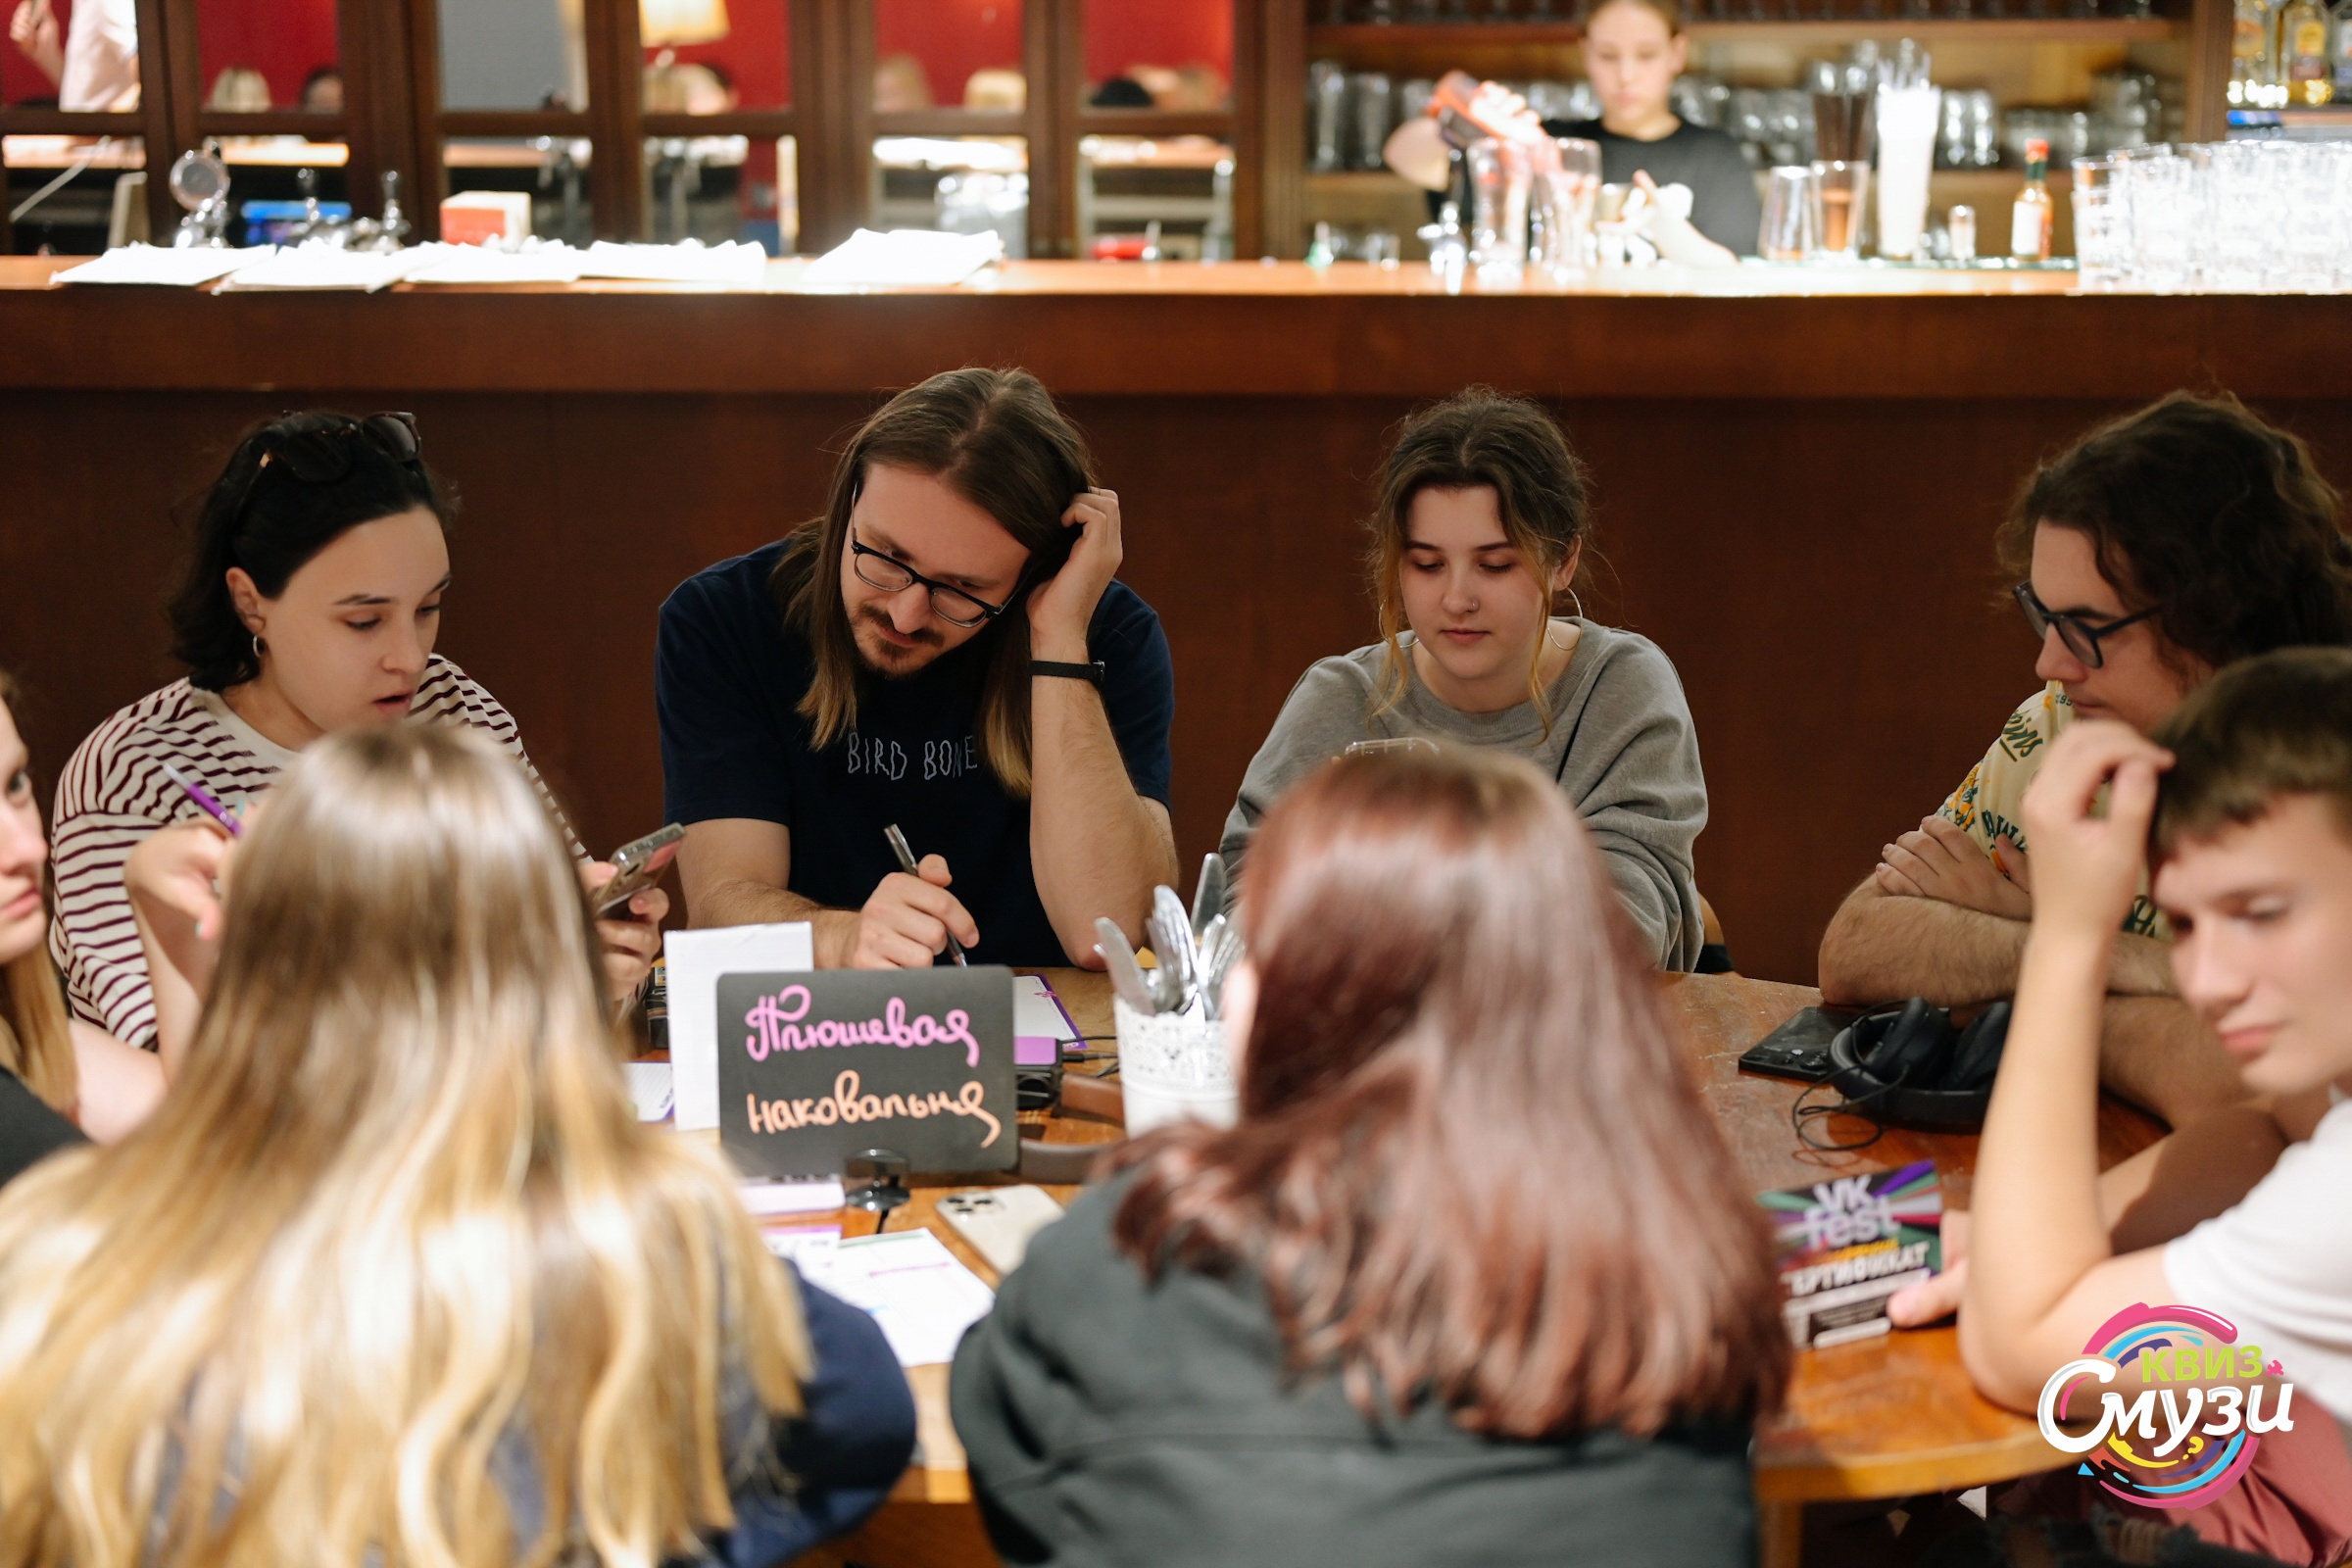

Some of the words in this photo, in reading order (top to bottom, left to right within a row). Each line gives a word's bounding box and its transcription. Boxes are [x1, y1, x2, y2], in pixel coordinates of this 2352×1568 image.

[848, 732, 907, 781] BIRD
[745, 985, 979, 1068] Плюшевая
[1813, 1174, 1873, 1211] VK
[1804, 1195, 1901, 1251] fest
